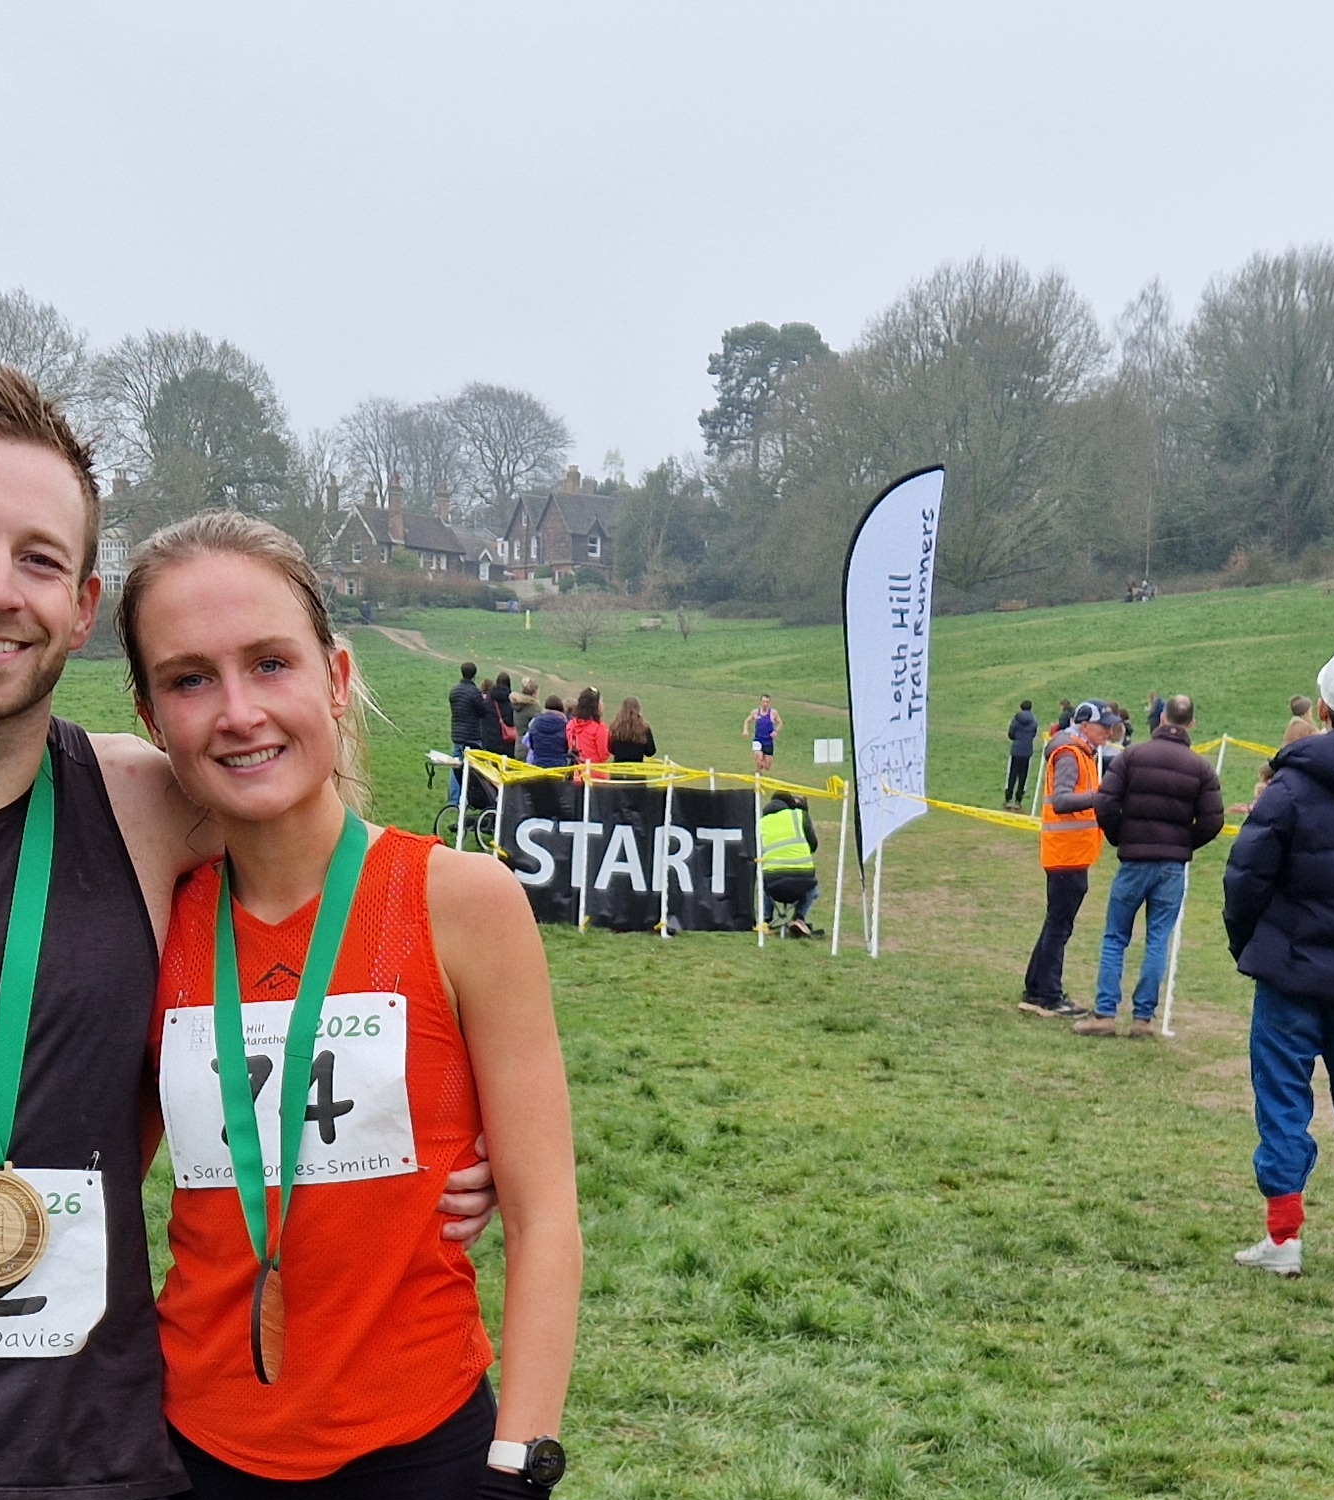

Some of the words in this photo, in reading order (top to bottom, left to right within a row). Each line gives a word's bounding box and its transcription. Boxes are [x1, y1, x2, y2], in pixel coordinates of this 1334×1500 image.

[888, 573, 912, 628] Hill
[913, 508, 935, 636] Runners
[908, 648, 924, 720] Trail
[513, 817, 743, 894] START
[246, 1023, 265, 1034] Hill
